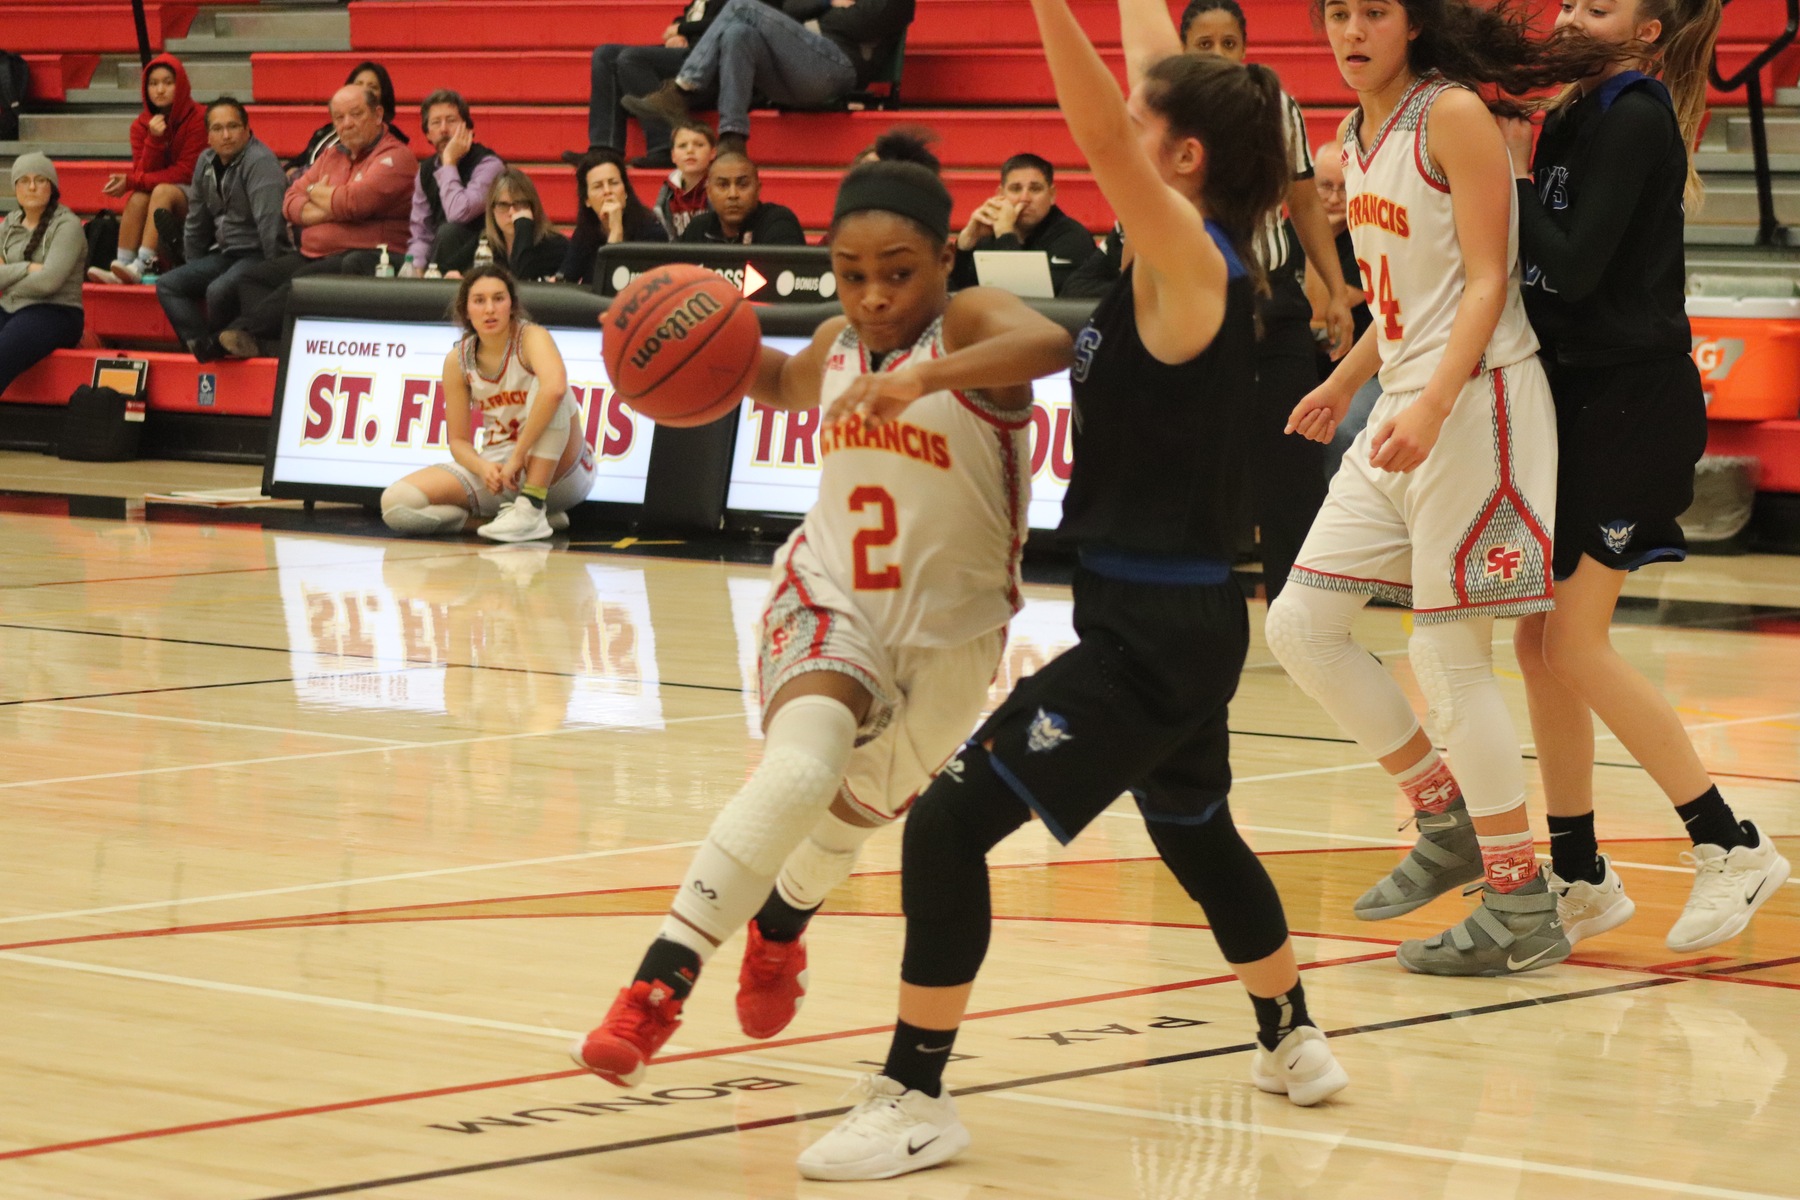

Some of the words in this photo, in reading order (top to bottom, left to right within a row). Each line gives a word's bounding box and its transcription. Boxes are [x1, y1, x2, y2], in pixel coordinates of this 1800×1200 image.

[1347, 192, 1411, 240] FRANCIS
[794, 276, 820, 292] BONUS
[306, 339, 381, 357] WELCOME
[386, 343, 407, 359] TO
[629, 291, 722, 370] Wilson
[302, 371, 379, 445] ST.
[849, 485, 902, 591] 2
[1485, 544, 1523, 581] SF
[1417, 778, 1454, 807] SF
[1489, 861, 1530, 884] SF
[1009, 1016, 1211, 1046] PAX
[427, 1076, 802, 1135] BONUM
